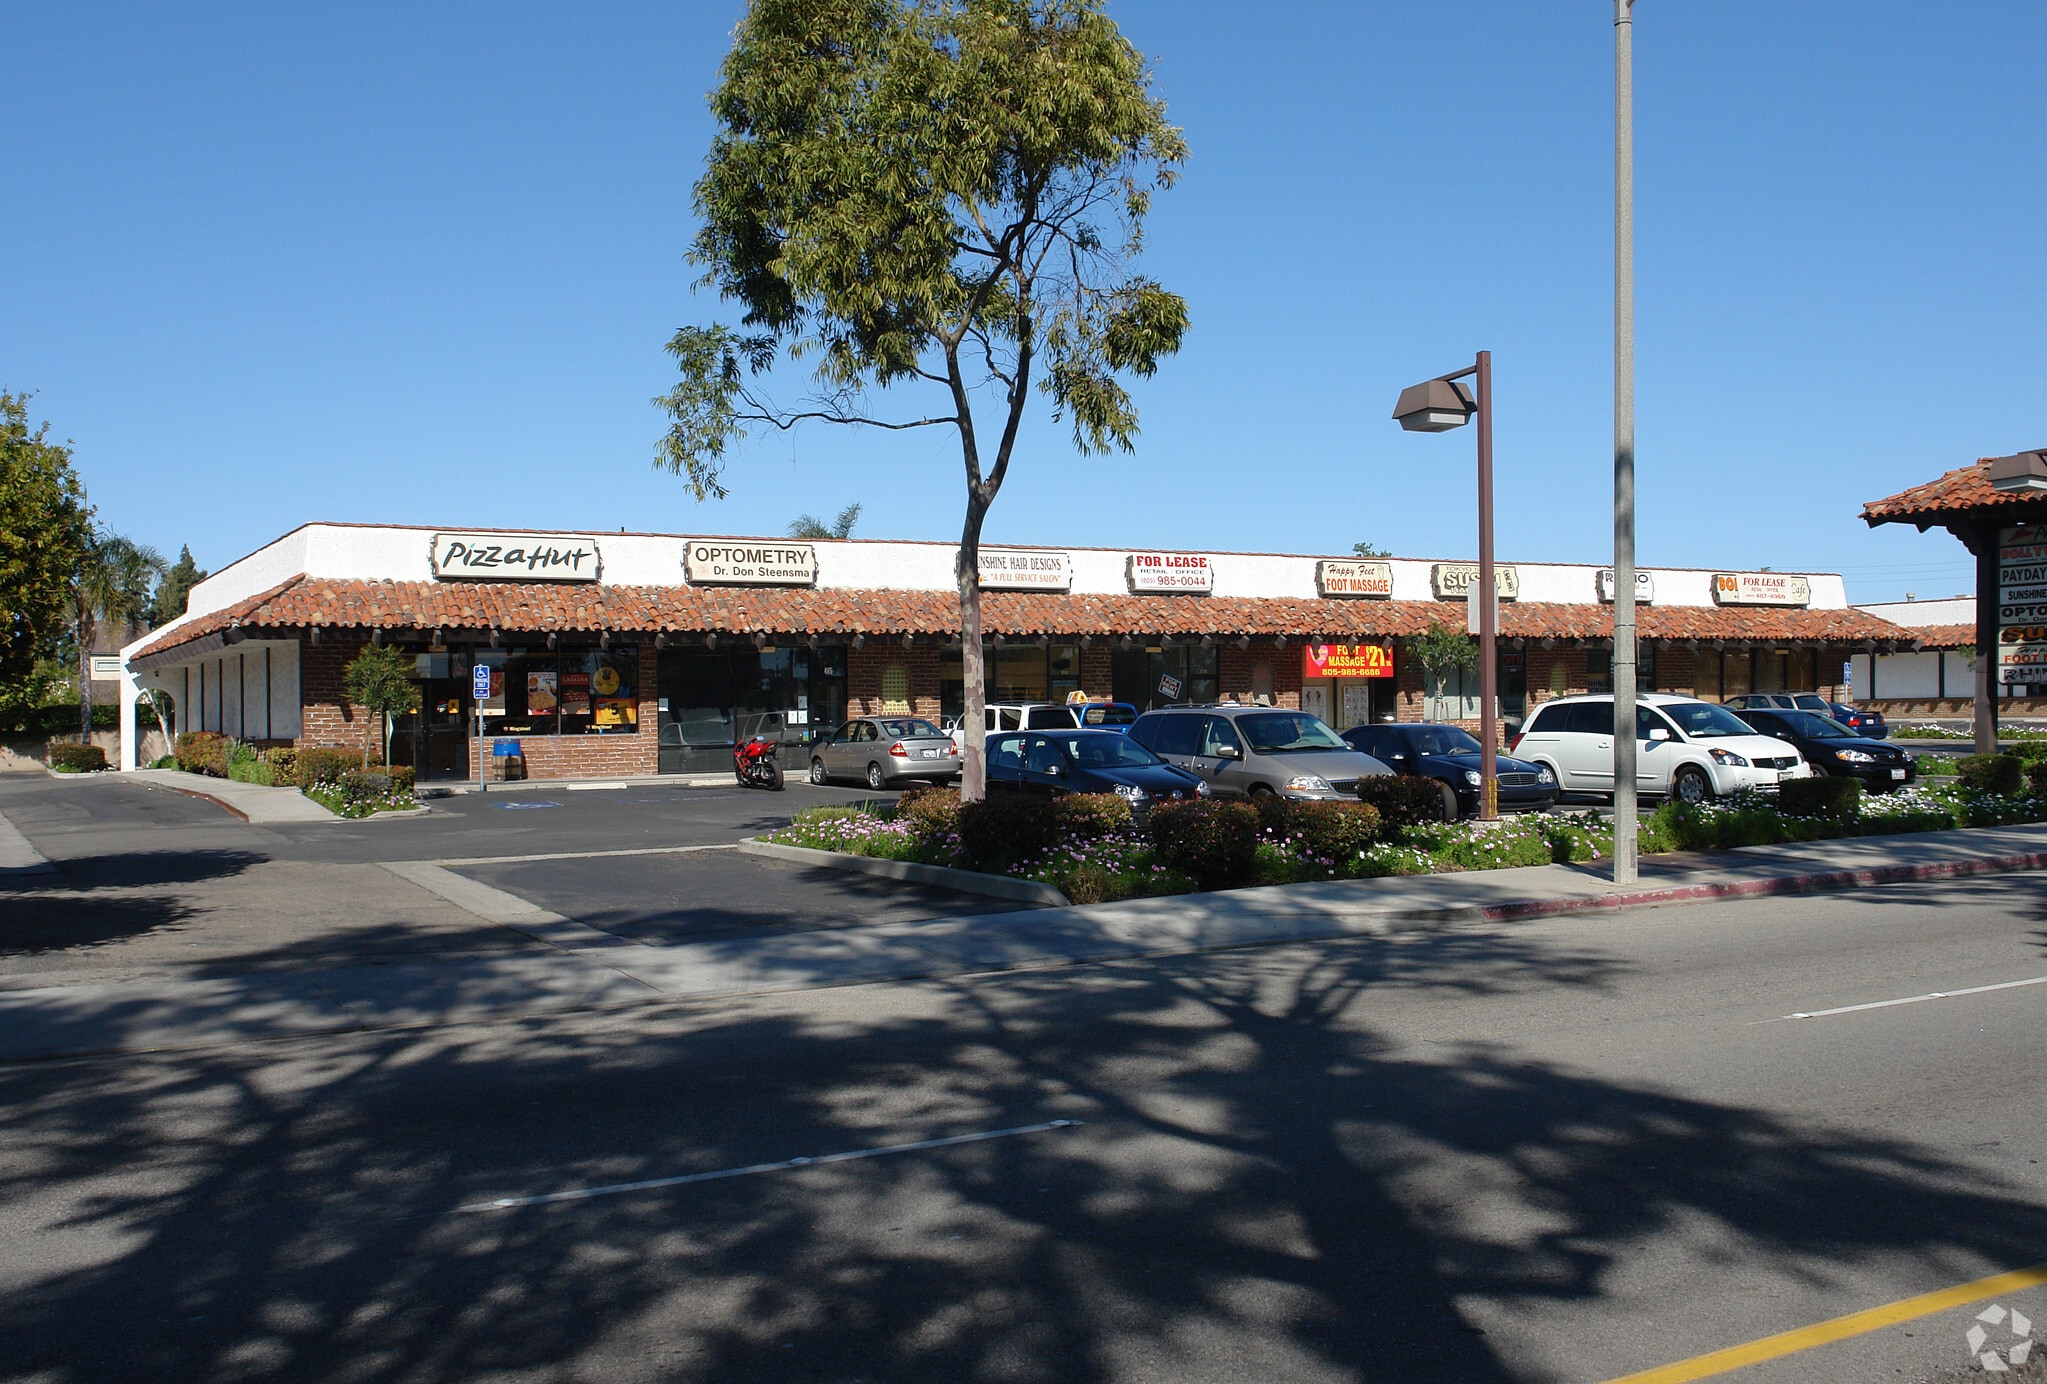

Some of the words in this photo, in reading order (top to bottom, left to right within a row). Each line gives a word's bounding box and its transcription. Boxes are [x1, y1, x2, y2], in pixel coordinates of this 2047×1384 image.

[695, 547, 808, 564] OPTOMETRY
[1136, 555, 1162, 567] FOR
[1165, 556, 1207, 568] LEASE
[1010, 557, 1028, 570] HAIR
[1030, 557, 1061, 571] DESIGNS
[1328, 563, 1355, 577] Happy
[1358, 564, 1375, 577] Feet
[714, 565, 729, 576] Dr.
[733, 566, 754, 576] Don
[758, 567, 810, 578] Steensma
[1014, 573, 1037, 582] SERVICE
[2002, 567, 2047, 582] PAYDAY
[1157, 576, 1206, 586] 985-0044
[1326, 578, 1348, 591] FOOT
[1350, 578, 1389, 592] MASSAGE
[1743, 577, 1760, 586] FOR
[1761, 578, 1786, 587] LEASE
[2008, 589, 2047, 601] SUNSHINE
[1336, 644, 1361, 656] FOT
[1328, 656, 1366, 667] MASSAGE
[2004, 653, 2040, 664] FOOT
